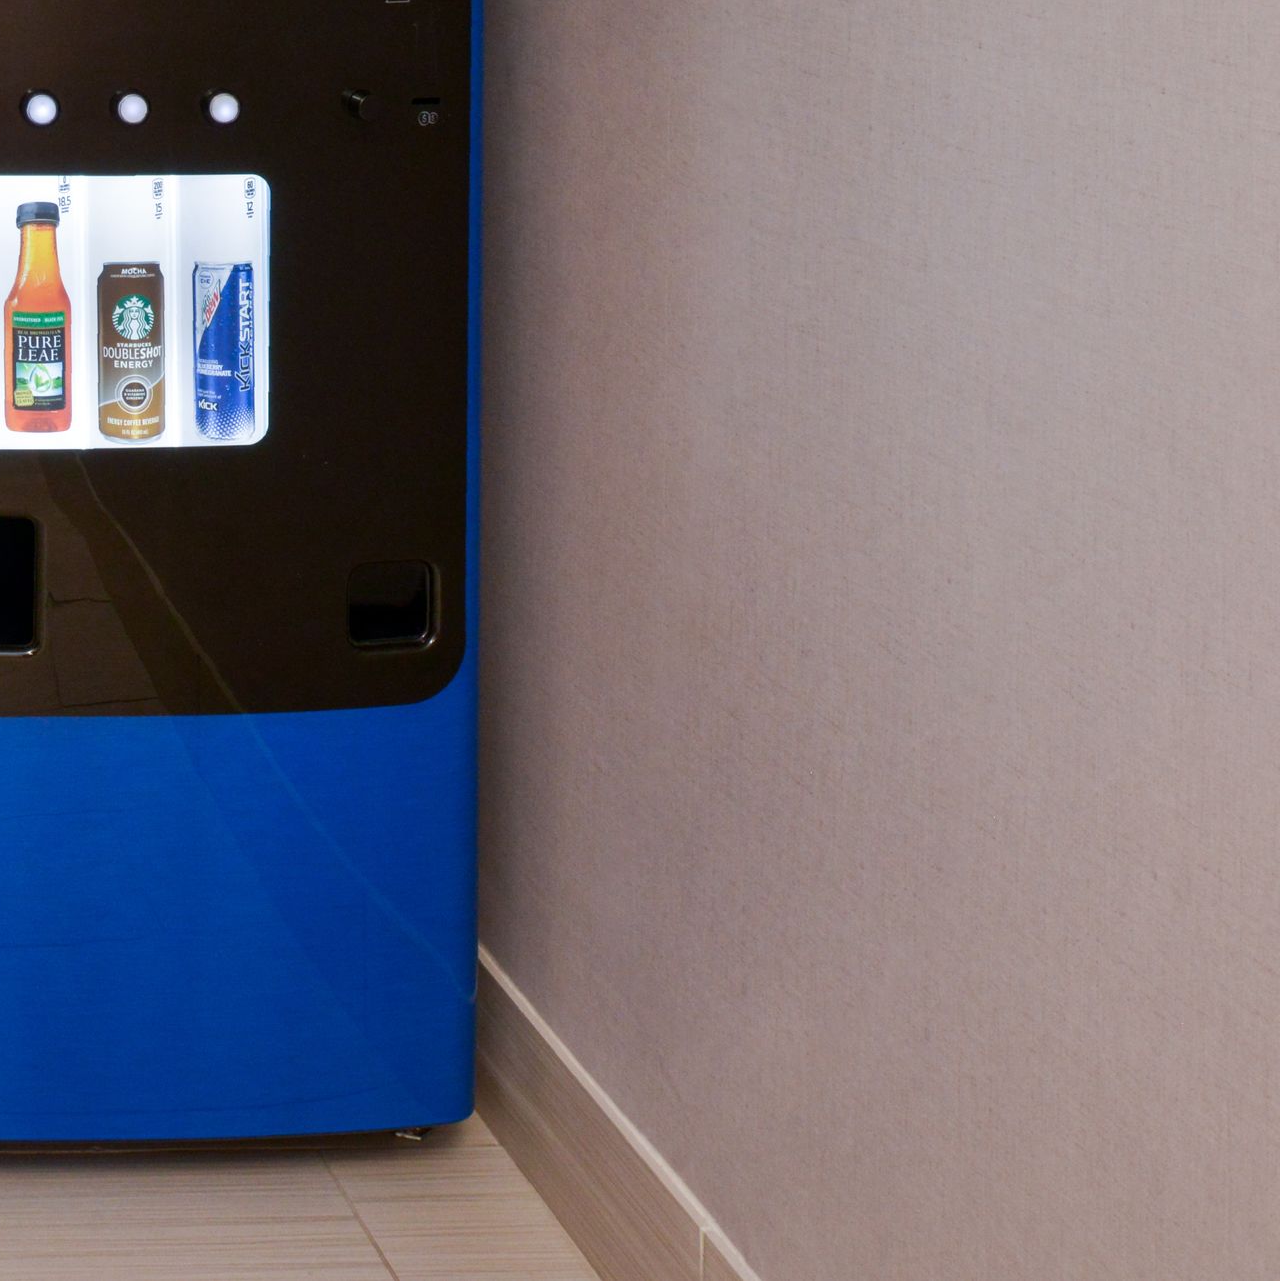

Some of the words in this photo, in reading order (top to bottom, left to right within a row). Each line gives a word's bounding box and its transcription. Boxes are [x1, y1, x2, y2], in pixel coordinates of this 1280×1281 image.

[235, 278, 251, 391] KICKSTART
[18, 335, 61, 348] PURE
[103, 345, 162, 359] DOUBLESHOT
[114, 360, 153, 369] ENERGY
